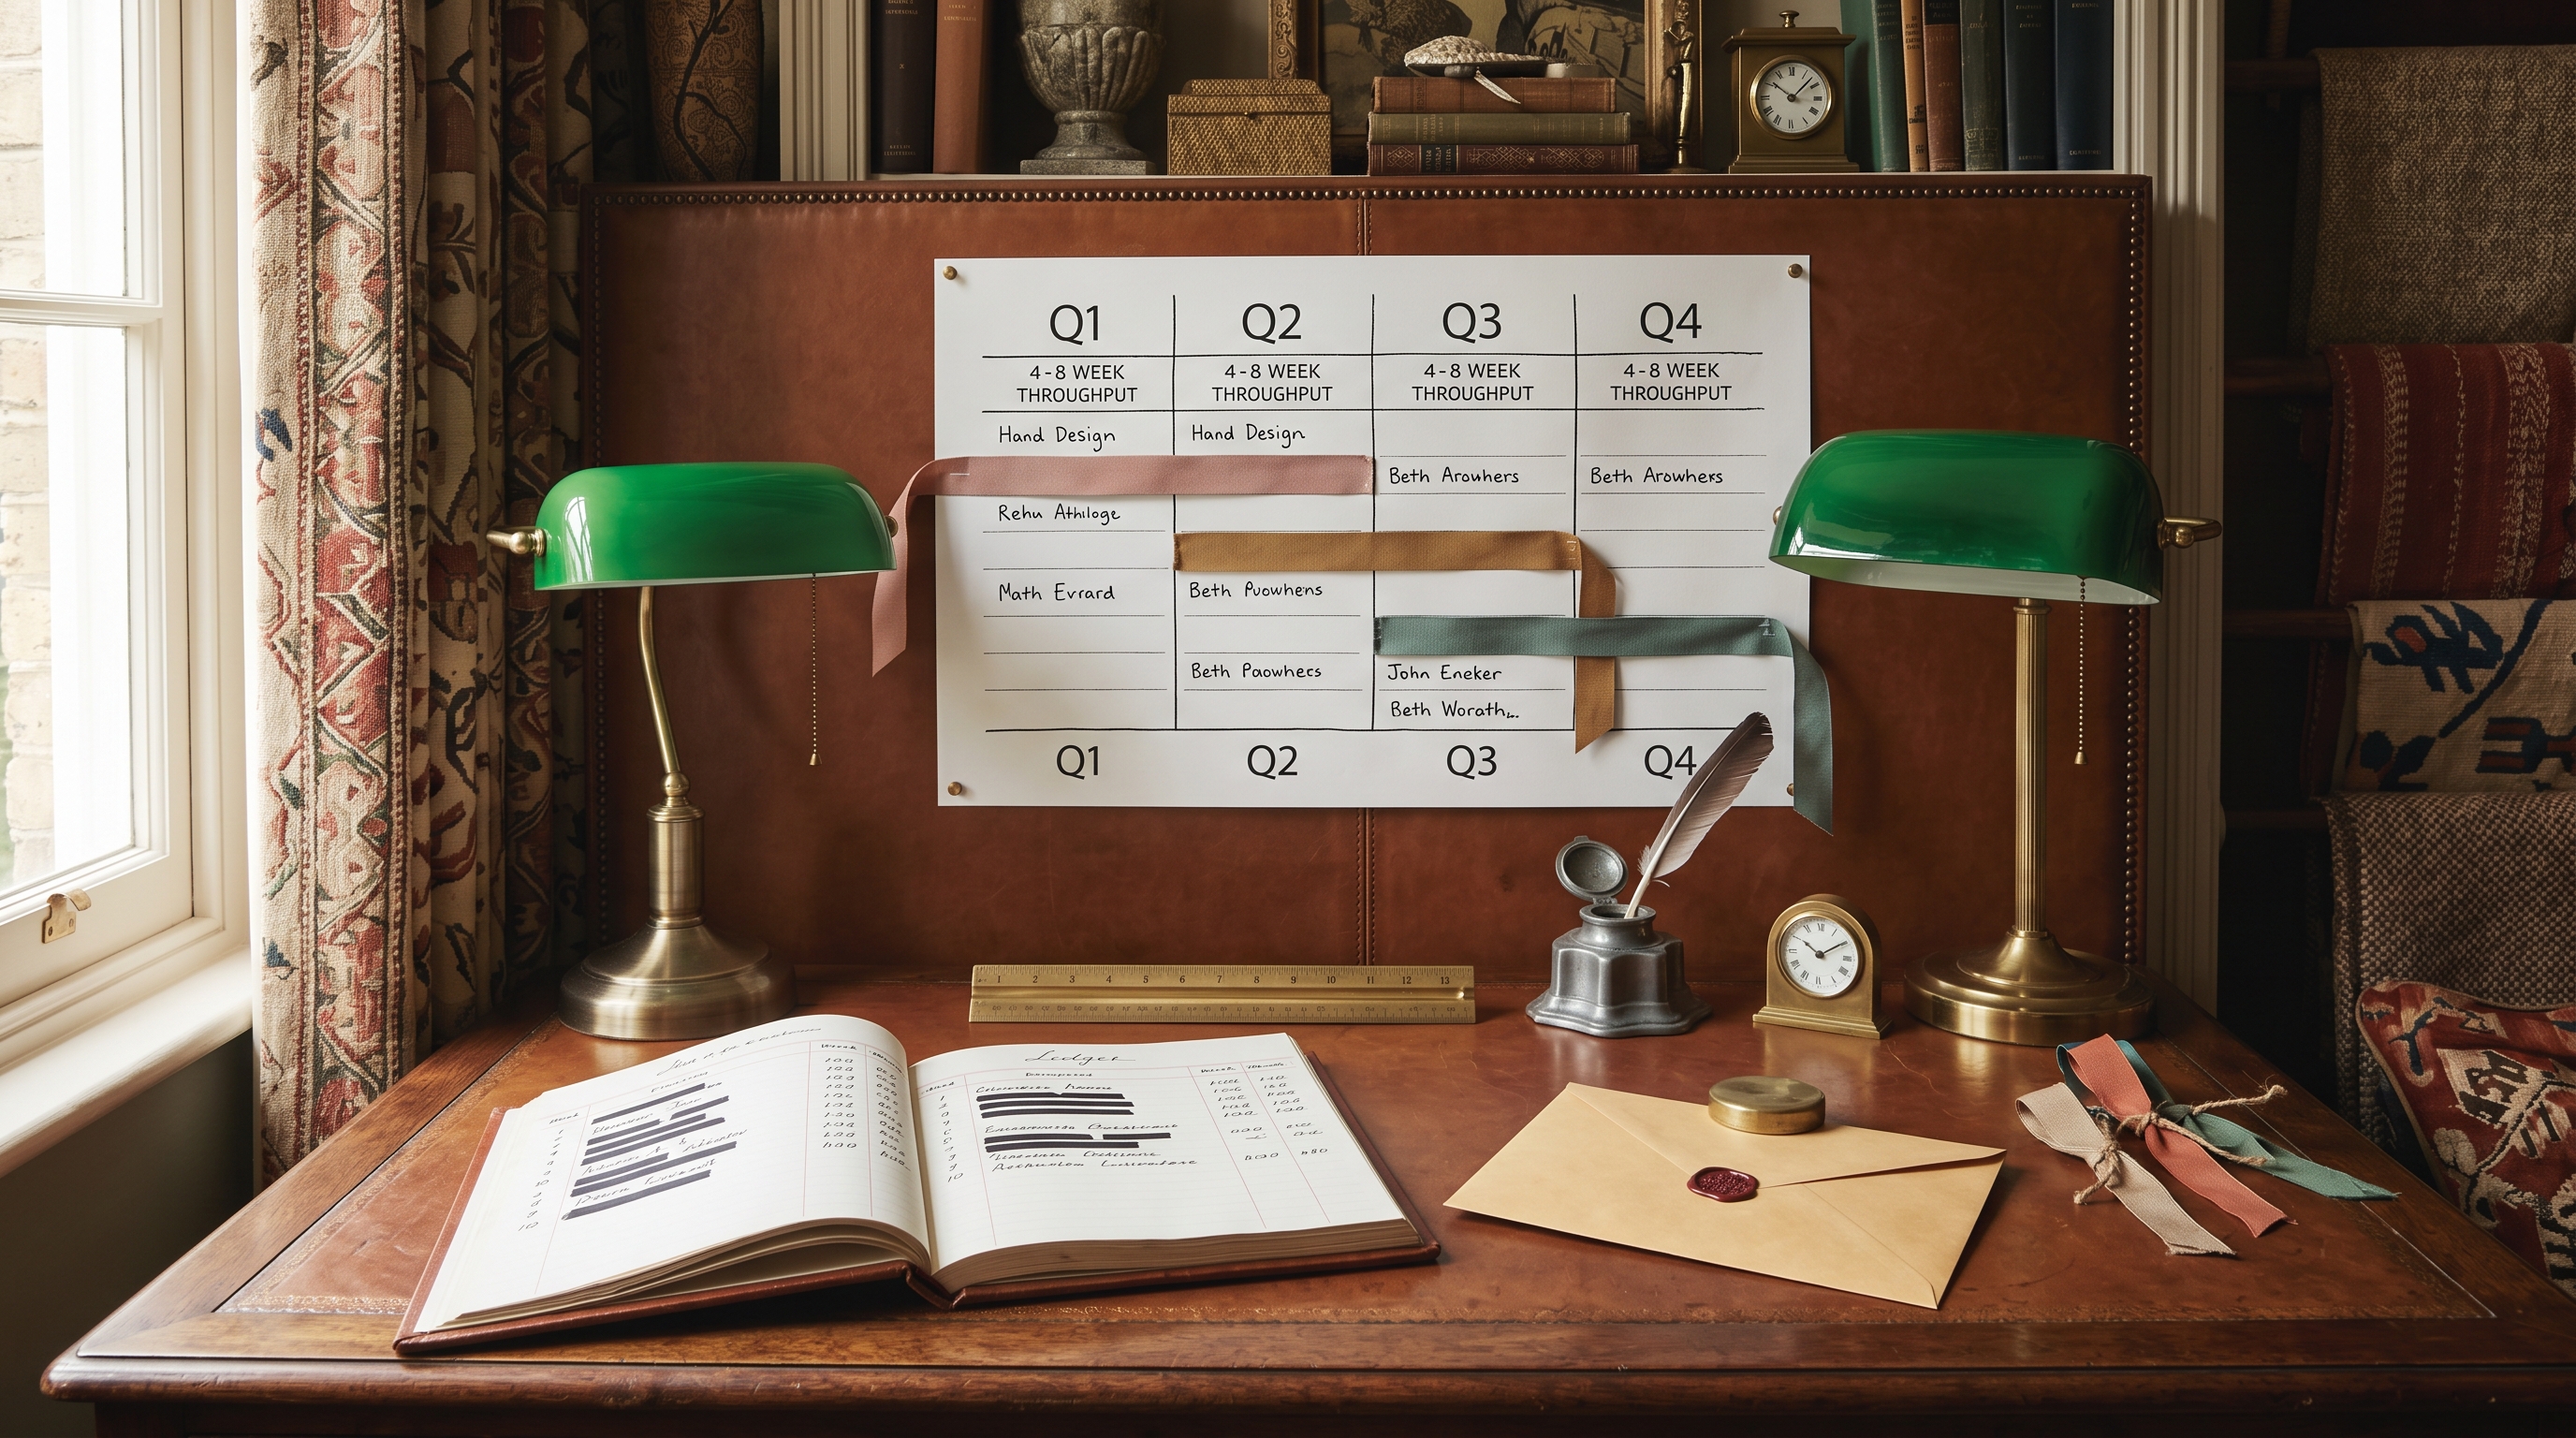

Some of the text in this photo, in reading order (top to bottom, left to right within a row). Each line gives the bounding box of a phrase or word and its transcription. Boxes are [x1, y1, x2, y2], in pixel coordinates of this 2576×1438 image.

[1049, 303, 1099, 346] Q1
[1242, 302, 1302, 345] Q2
[1442, 301, 1502, 345] Q3
[1640, 301, 1703, 345] Q4
[1072, 364, 1125, 380] WEEK
[1267, 363, 1321, 379] WEEK
[1467, 362, 1521, 378] WEEK
[1666, 362, 1720, 378] WEEK
[1016, 387, 1138, 404] THROUGHPUT
[1211, 386, 1334, 402] THROUGHPUT
[1411, 386, 1535, 402] THROUGHPUT
[1609, 385, 1733, 401] THROUGHPUT
[999, 425, 1116, 453] Hand Design
[1192, 423, 1306, 449] Hand Design
[1389, 466, 1430, 485] Beth
[1590, 466, 1633, 485] Beth
[999, 582, 1116, 602] Math Evrard
[1190, 581, 1232, 598] Beth
[1191, 662, 1231, 680] Beth
[1387, 663, 1502, 681] John Eneker
[1390, 700, 1431, 717] Beth
[1056, 744, 1099, 781] Q1
[1247, 744, 1298, 781] Q2
[1446, 744, 1498, 781] Q3
[1644, 744, 1697, 780] Q4
[1032, 975, 1038, 984] 2
[1069, 975, 1076, 984] 3
[1105, 975, 1112, 984] 4
[1143, 975, 1149, 984] 5
[1179, 975, 1186, 984] 6
[1217, 975, 1222, 984] 7
[1253, 976, 1260, 984] 8
[1291, 976, 1296, 984] 9
[1326, 976, 1337, 984] 10
[1402, 976, 1412, 985] 12
[1441, 976, 1450, 985] 13
